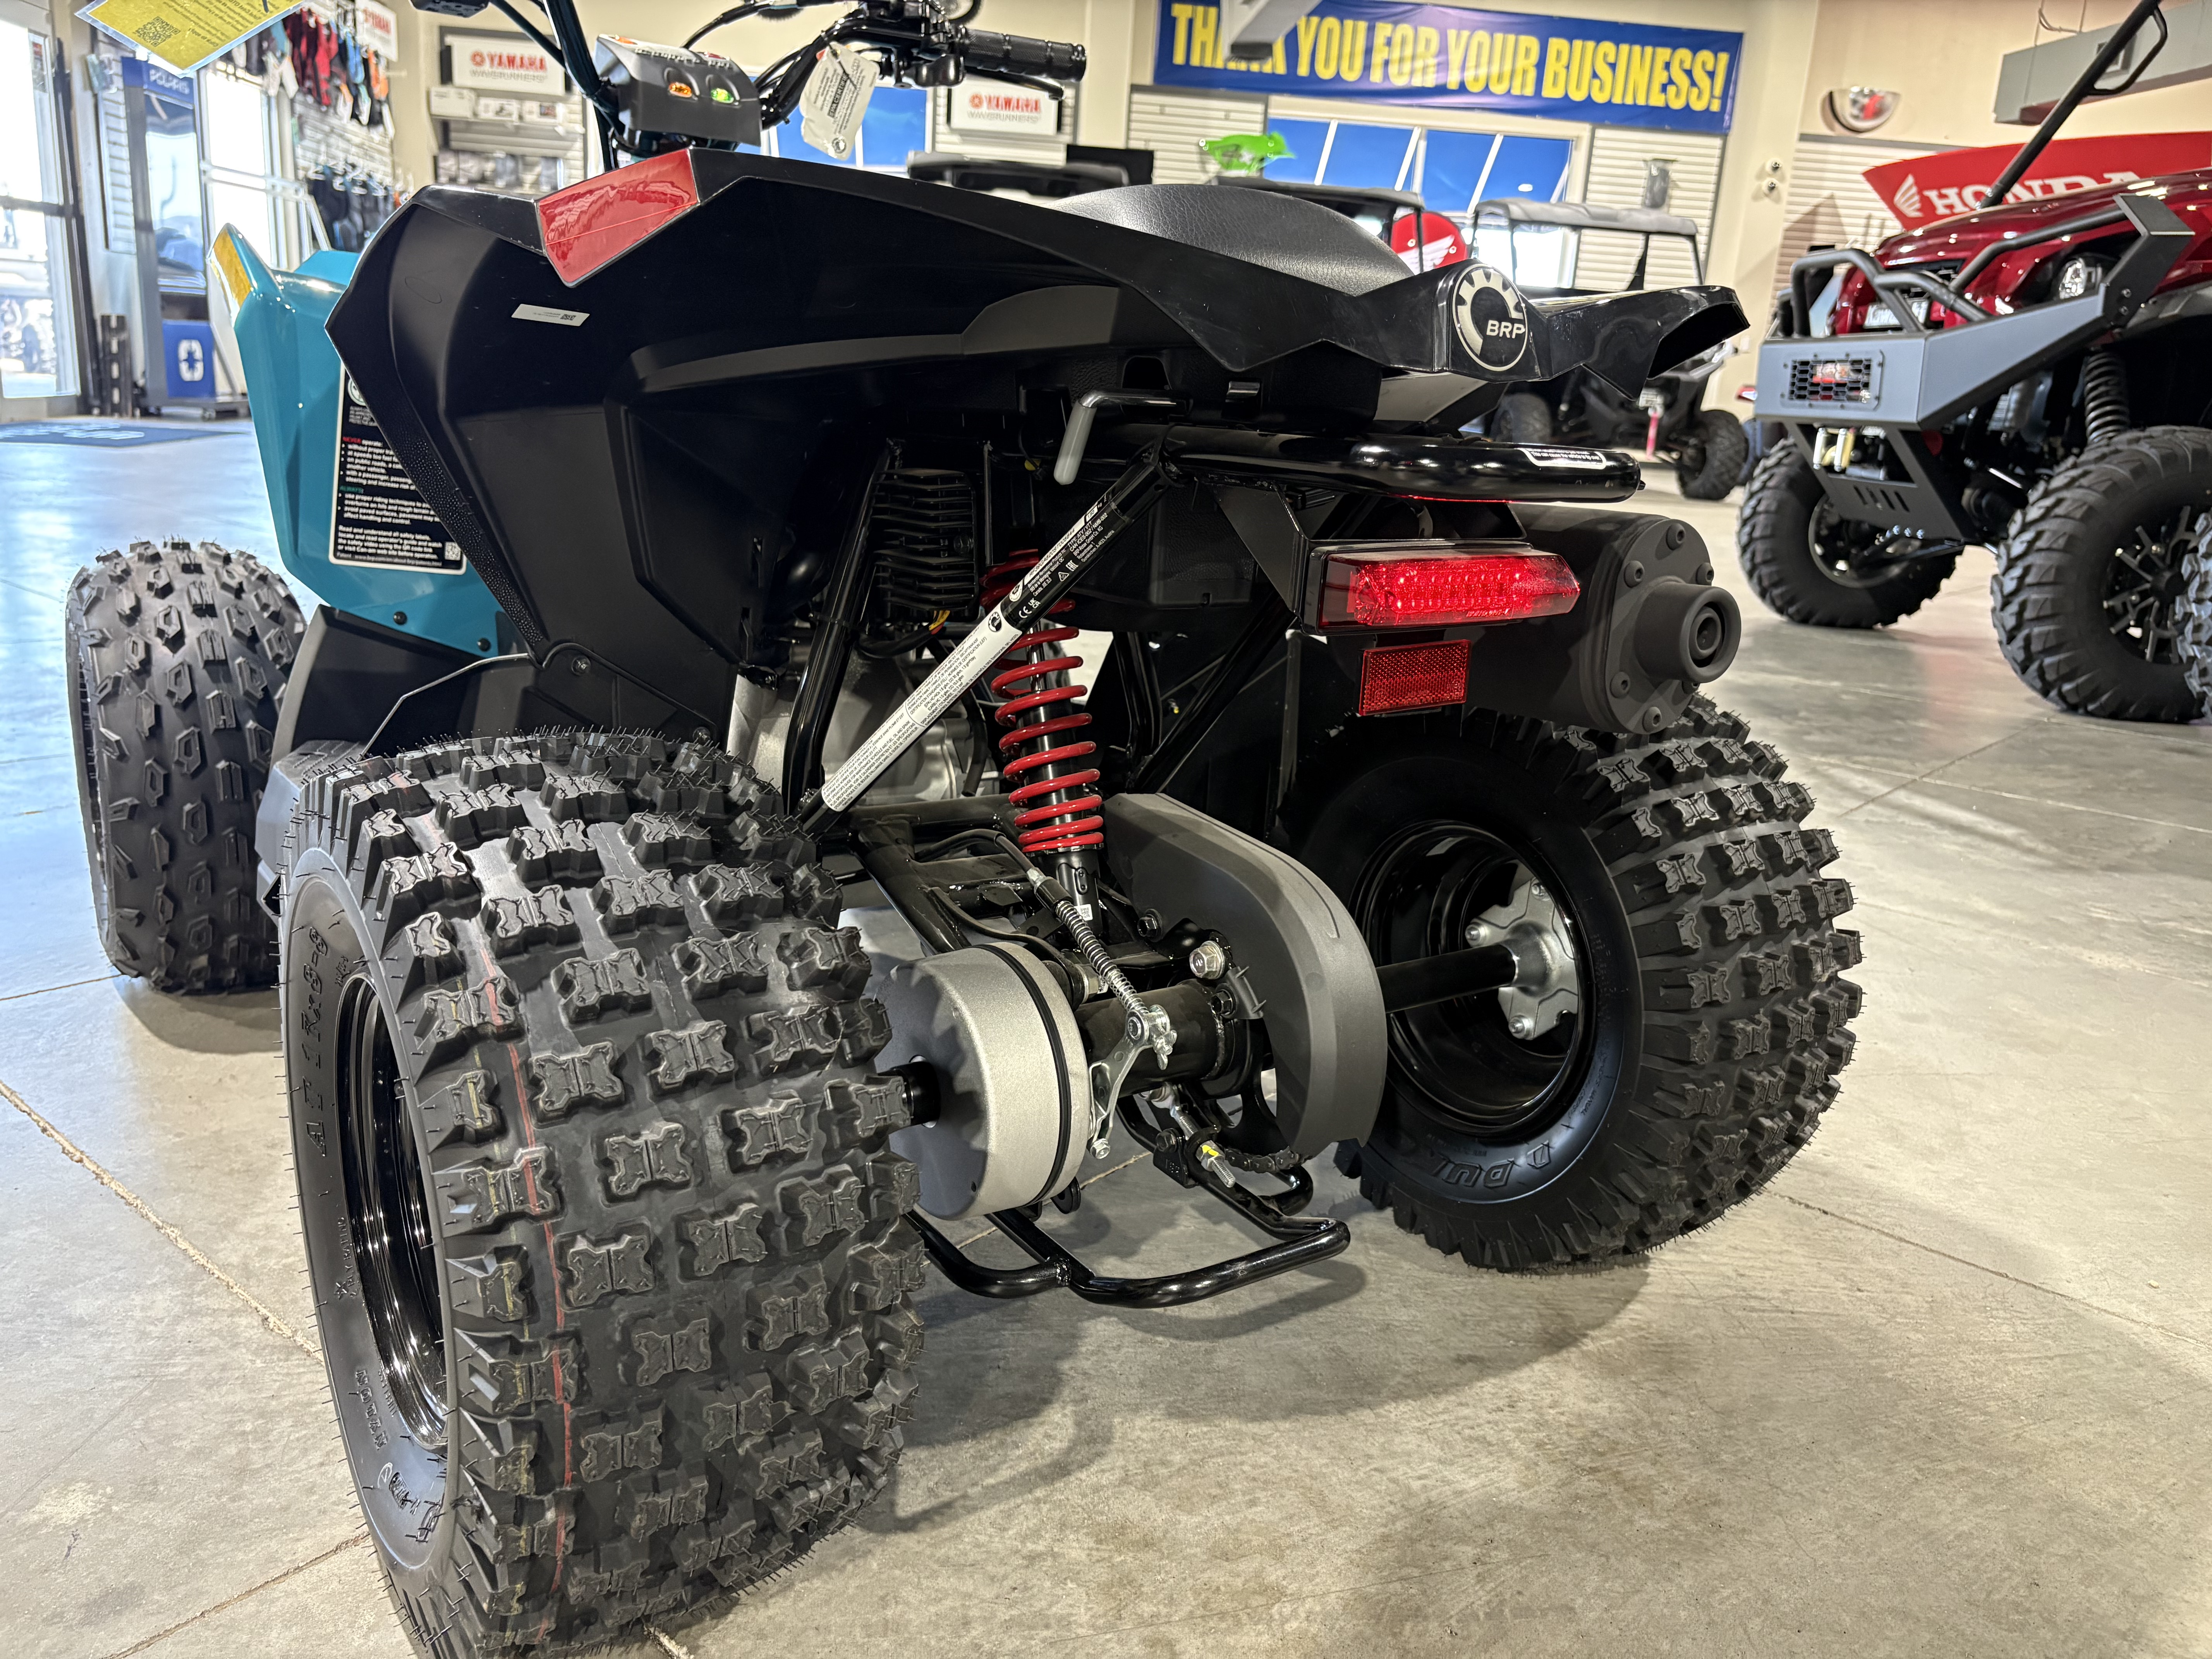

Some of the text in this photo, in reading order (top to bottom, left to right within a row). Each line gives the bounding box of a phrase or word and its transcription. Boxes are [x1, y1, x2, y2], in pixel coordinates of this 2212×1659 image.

[487, 50, 547, 72] YAMAHA
[1297, 16, 1368, 82] YOU
[1370, 22, 1439, 88] FOR
[1447, 29, 1540, 96] YOUR
[1542, 37, 1730, 112] BUSINESS!
[985, 94, 1041, 113] YAMAHA
[1486, 320, 1525, 338] BRP
[1075, 529, 1084, 538] ATV
[1084, 520, 1093, 529] VTT
[1069, 542, 1079, 552] CAN
[1028, 597, 1037, 606] UK
[1032, 600, 1041, 609] CA
[909, 696, 928, 715] CERTIFICATION
[926, 682, 941, 698] STANDARDS
[961, 642, 981, 663] CERTIFICATION
[855, 759, 871, 776] MAINTENANCE
[355, 1370, 387, 1450] NYLON
